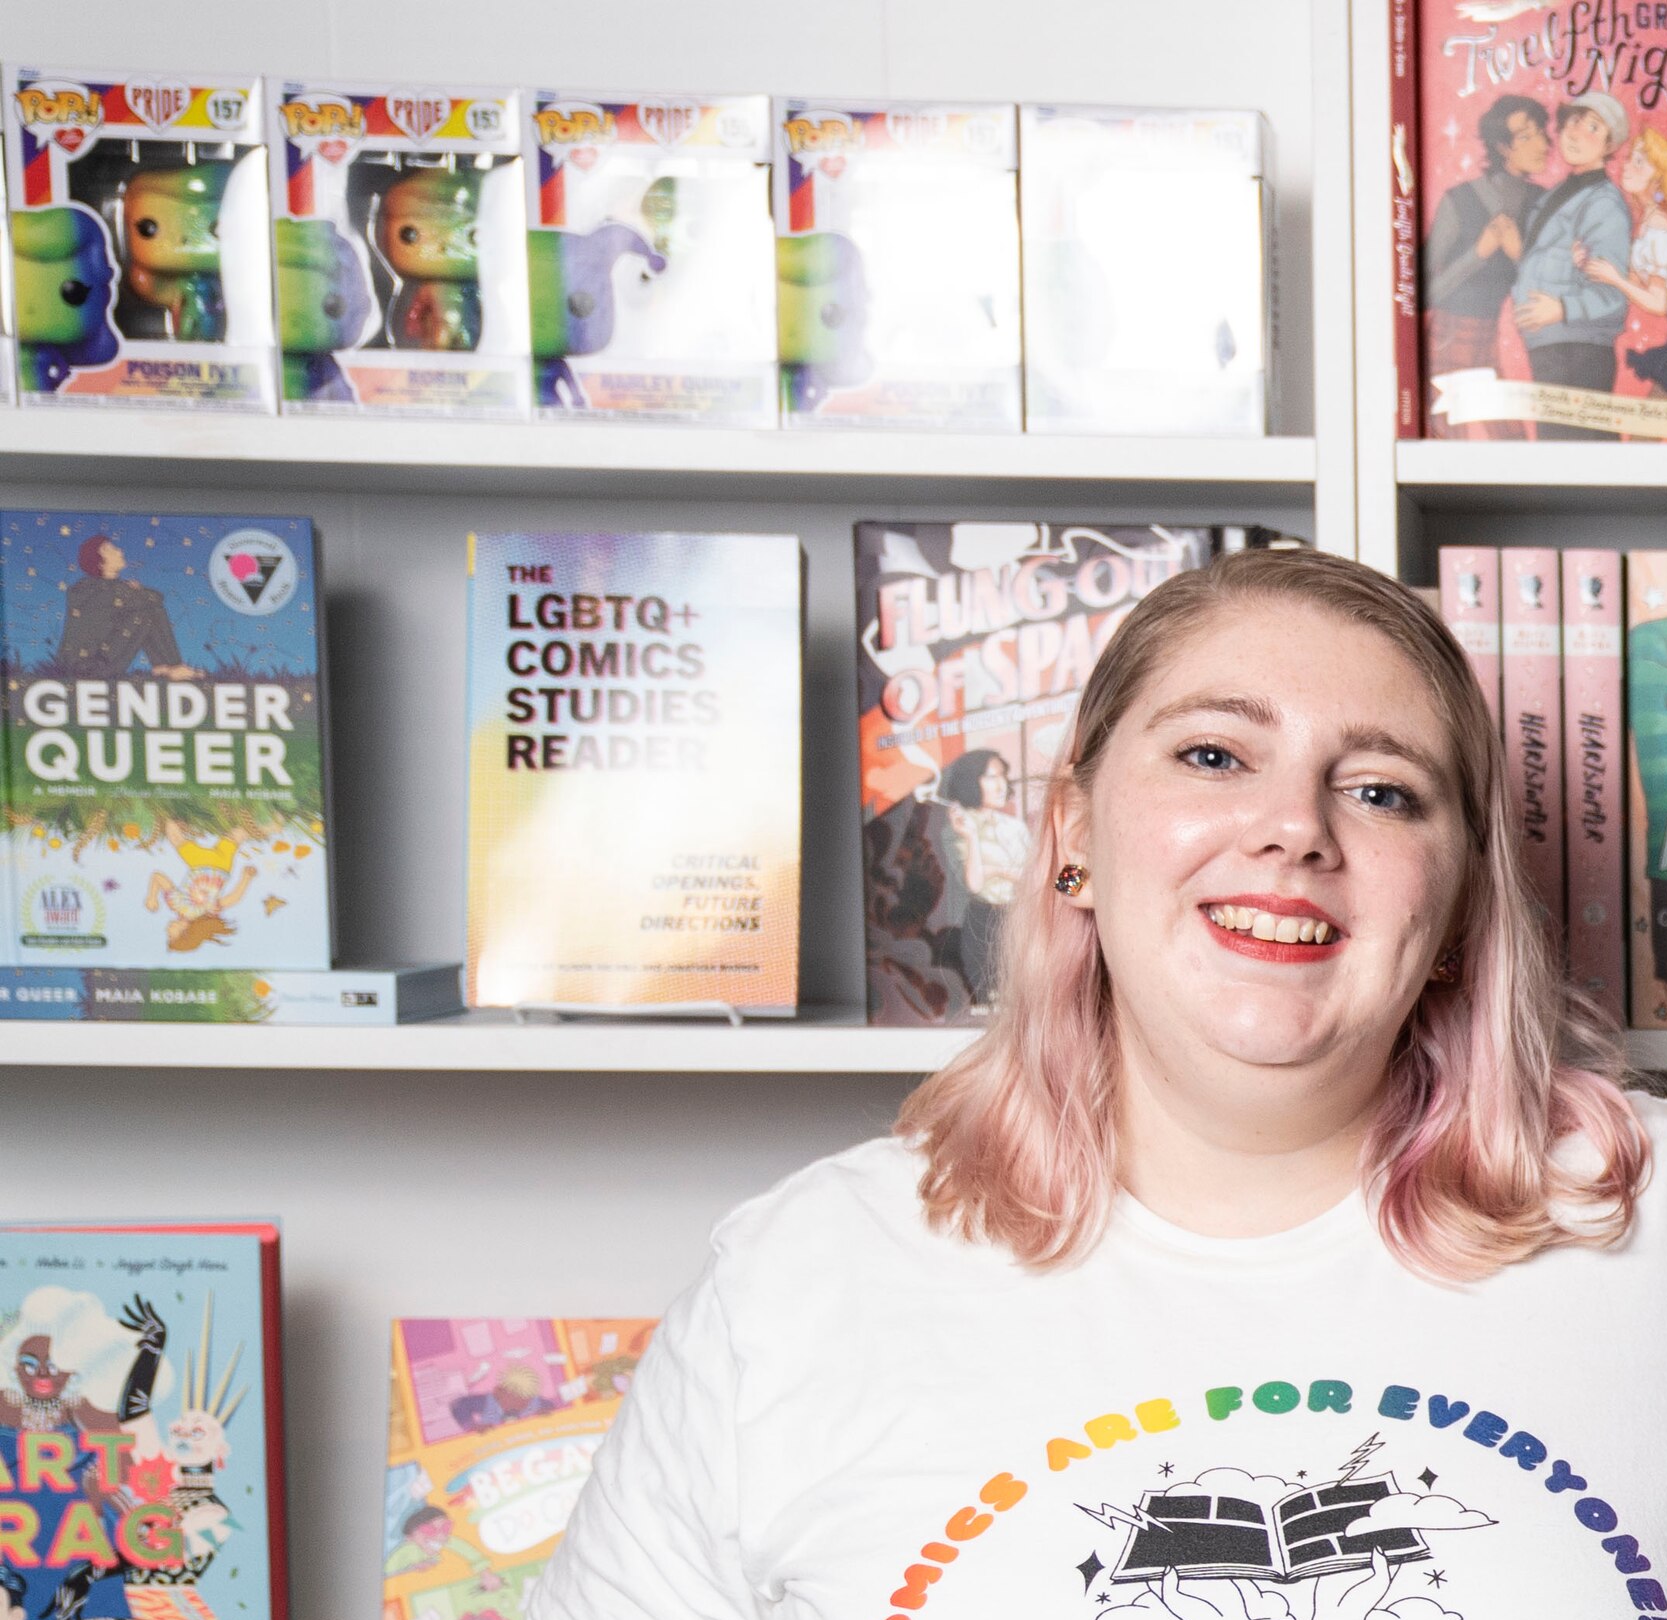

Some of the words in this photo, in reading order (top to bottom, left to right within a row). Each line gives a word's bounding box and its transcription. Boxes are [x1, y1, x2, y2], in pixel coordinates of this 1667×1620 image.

[131, 87, 184, 126] PRIDE
[213, 99, 243, 120] 157
[392, 99, 444, 136] PRIDE
[127, 360, 201, 381] POISON
[507, 565, 554, 585] THE
[507, 592, 701, 636] LGBTQ+
[879, 553, 1069, 652] FLUNG
[1074, 548, 1182, 609] OU
[506, 640, 706, 680] COMICS
[881, 648, 967, 722] OF
[23, 678, 295, 731] GENDER
[506, 687, 721, 725] STUDIES
[25, 728, 295, 786] QUEER
[507, 734, 709, 771] READER
[1578, 711, 1607, 844] HEARTSTOPPER
[672, 854, 761, 871] CRITICAL
[640, 915, 761, 932] DIRECTIONS
[682, 896, 762, 913] FUTURE
[94, 988, 144, 1003] MAIA
[150, 989, 218, 1004] KOBABE
[1046, 1397, 1182, 1472] ARE
[1204, 1379, 1354, 1422] FOR
[0, 1499, 185, 1569] RAG
